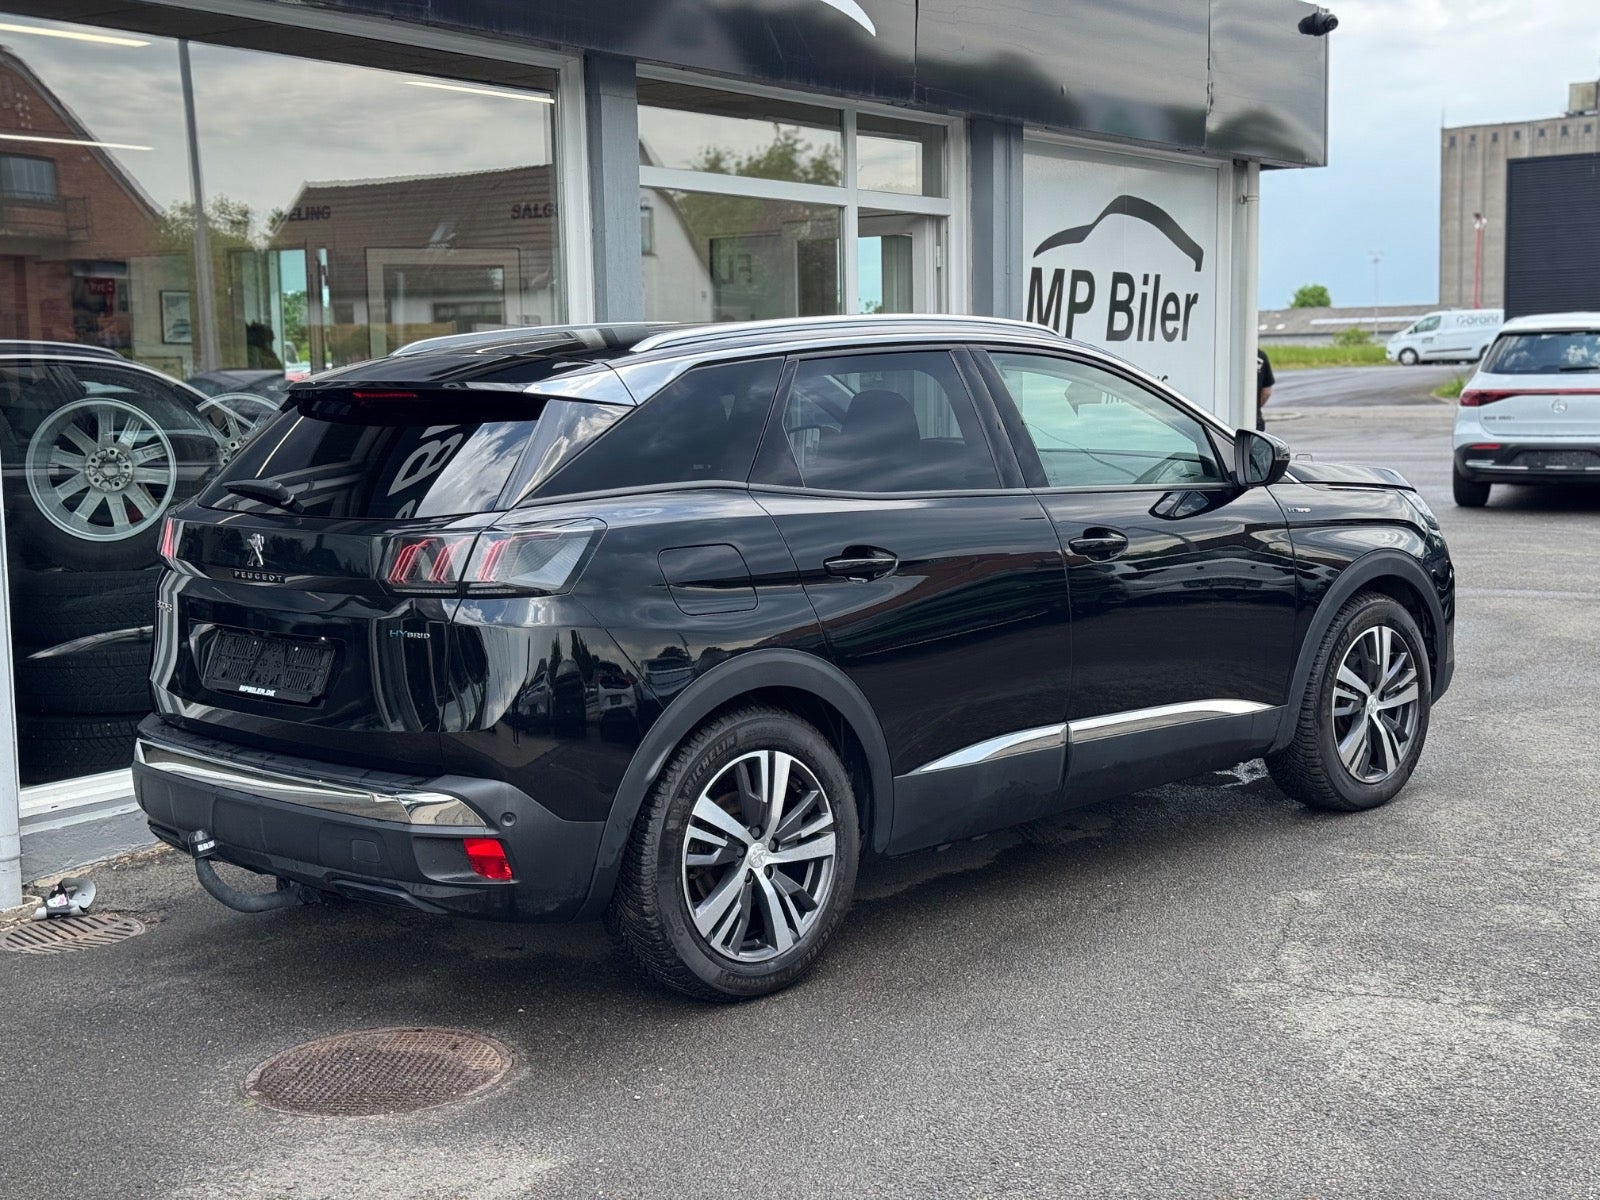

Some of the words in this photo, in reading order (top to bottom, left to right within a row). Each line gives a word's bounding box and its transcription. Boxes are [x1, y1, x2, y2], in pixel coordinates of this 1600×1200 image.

[1026, 266, 1096, 339] MP
[1106, 271, 1199, 343] Biler
[234, 570, 282, 582] PEUGEOT
